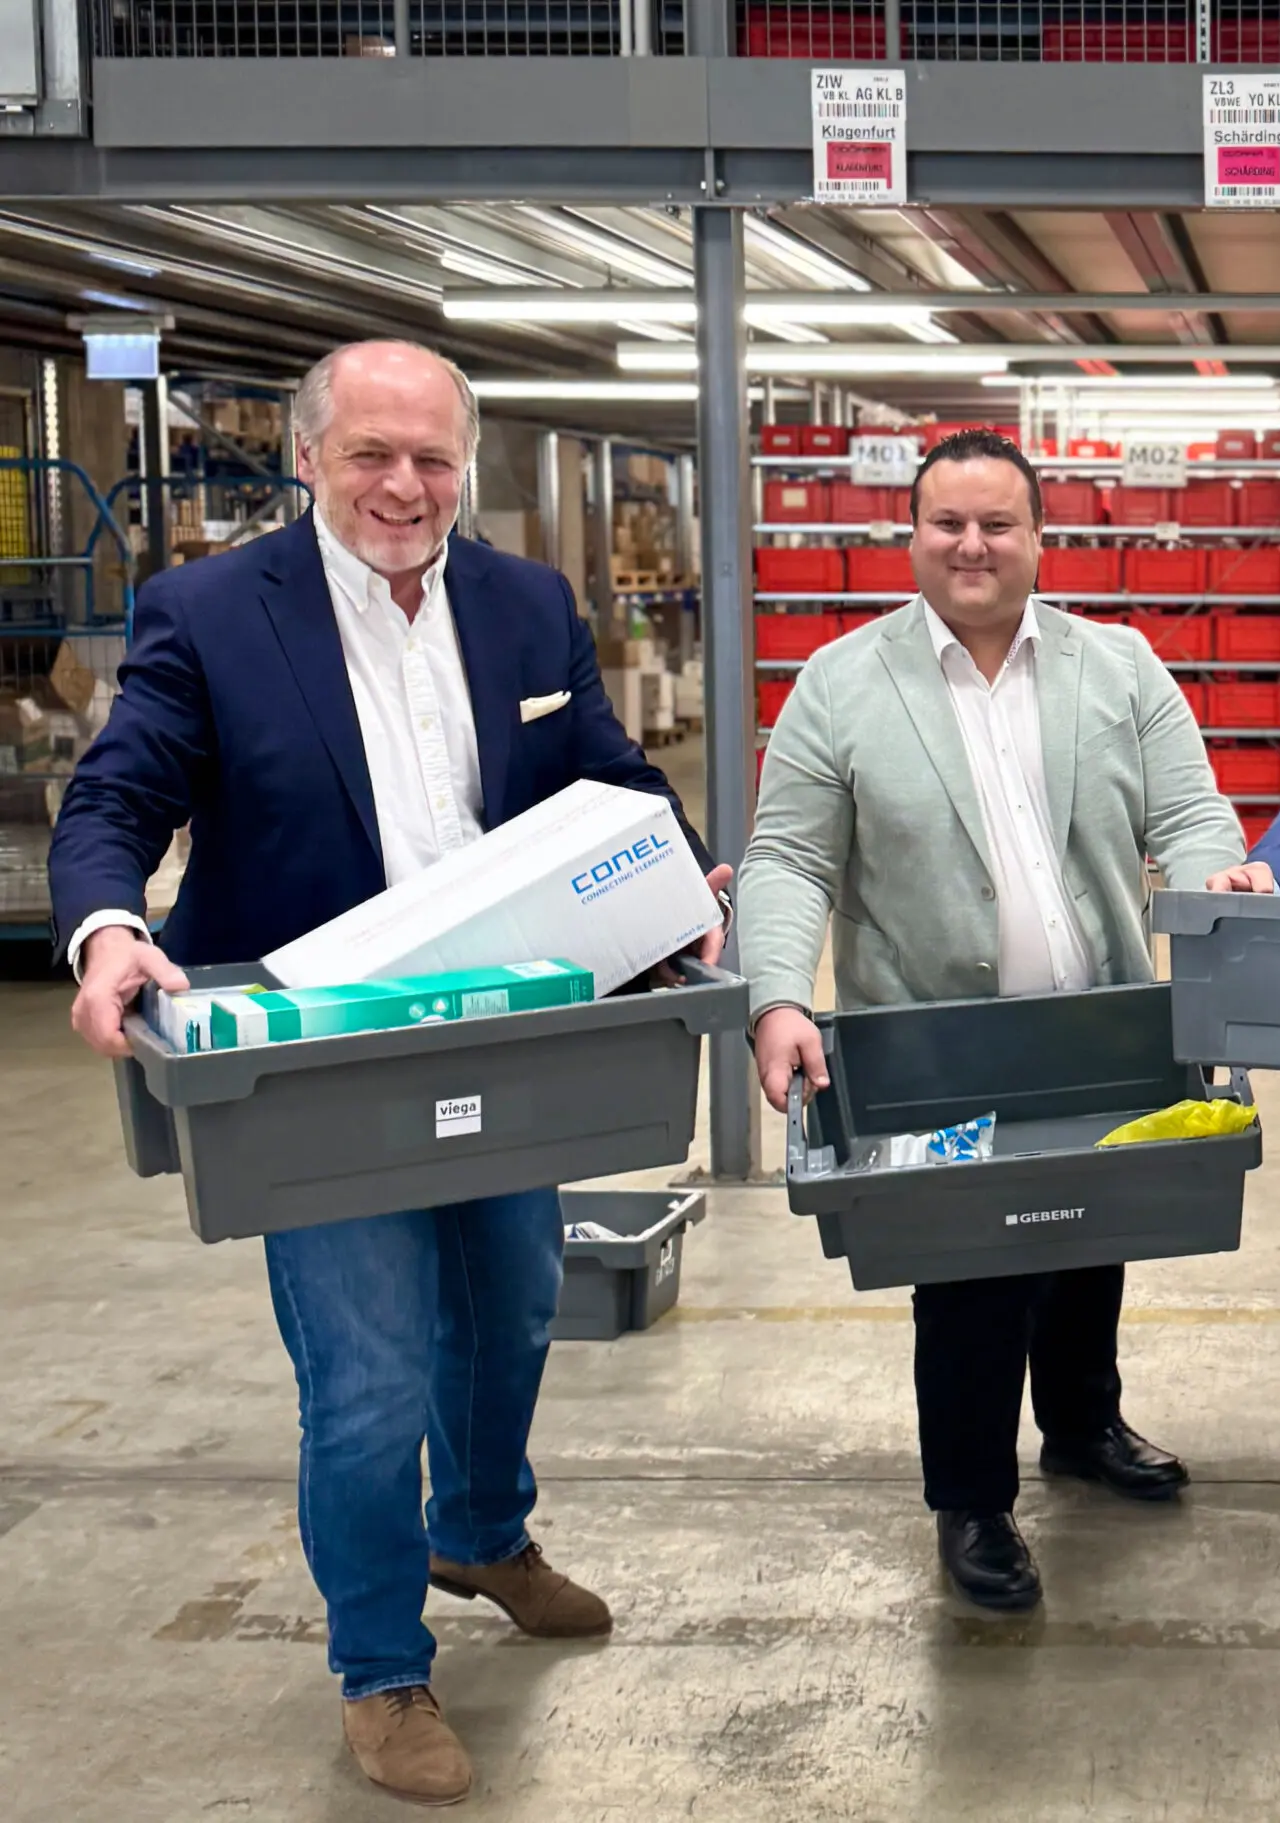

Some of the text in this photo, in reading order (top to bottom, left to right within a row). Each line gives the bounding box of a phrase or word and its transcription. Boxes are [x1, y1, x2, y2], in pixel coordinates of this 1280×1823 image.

[816, 74, 843, 89] ZIW
[1210, 80, 1235, 95] ZL3
[856, 87, 873, 101] AG
[876, 88, 893, 101] KL
[895, 88, 904, 101] B
[822, 124, 897, 140] Klagenfurt
[1129, 445, 1181, 466] M02
[571, 833, 670, 894] CONEL
[580, 847, 675, 906] CONNECTING ELEMENTS
[440, 1101, 477, 1116] viega
[1019, 1207, 1086, 1224] GEBERIT
